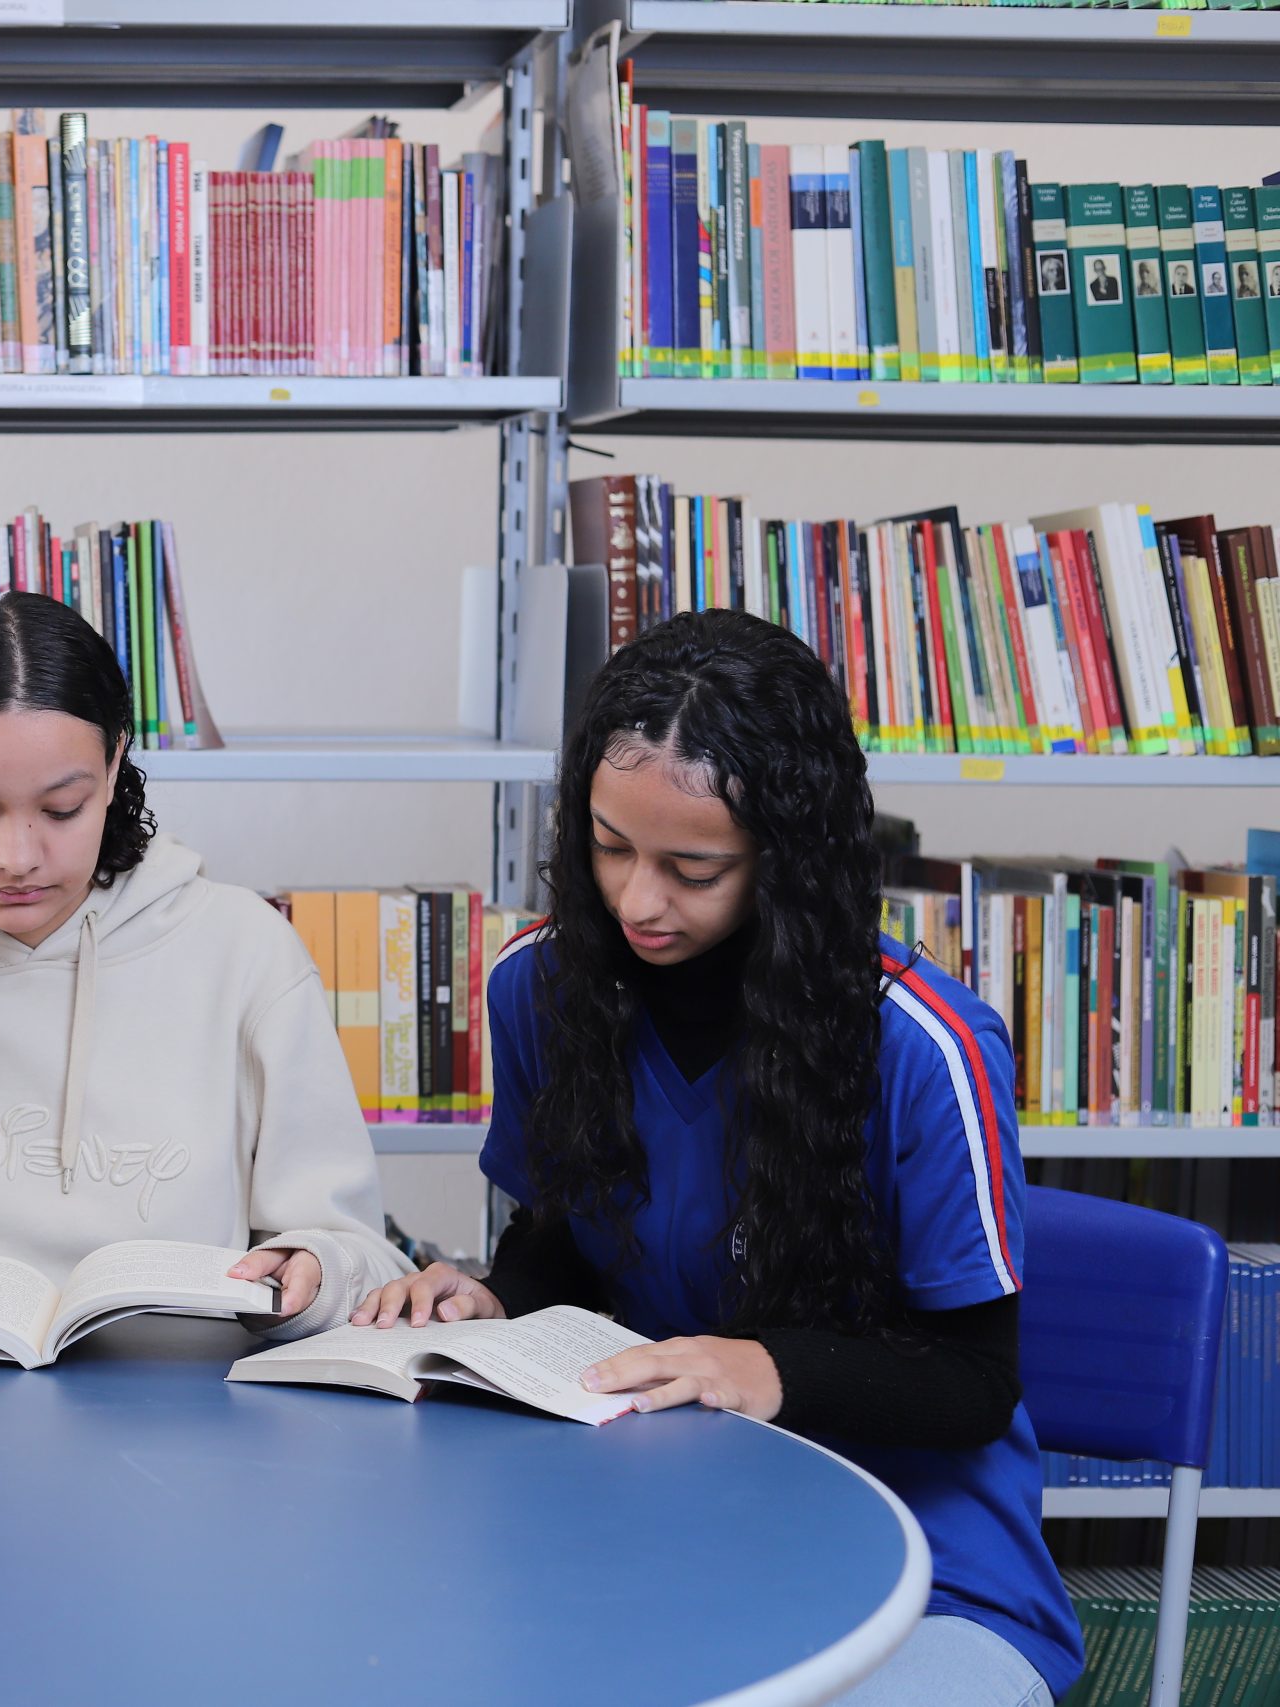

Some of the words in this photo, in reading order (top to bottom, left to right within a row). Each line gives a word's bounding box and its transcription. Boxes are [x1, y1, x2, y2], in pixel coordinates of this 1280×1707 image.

[174, 153, 184, 208] MARGARET
[731, 129, 745, 185] Vaqueiros
[766, 160, 779, 245] ANTOLOGIAS
[175, 209, 185, 254] ATWOOD
[734, 197, 746, 260] Cantadores
[175, 256, 185, 299] SEMENTE
[768, 249, 780, 265] DE
[770, 269, 783, 343] ANTOLOGIA
[420, 900, 430, 925] JOÃO
[421, 926, 430, 962] UBALDO
[398, 943, 413, 1001] UBALDO
[421, 964, 431, 1001] RIBEIRO
